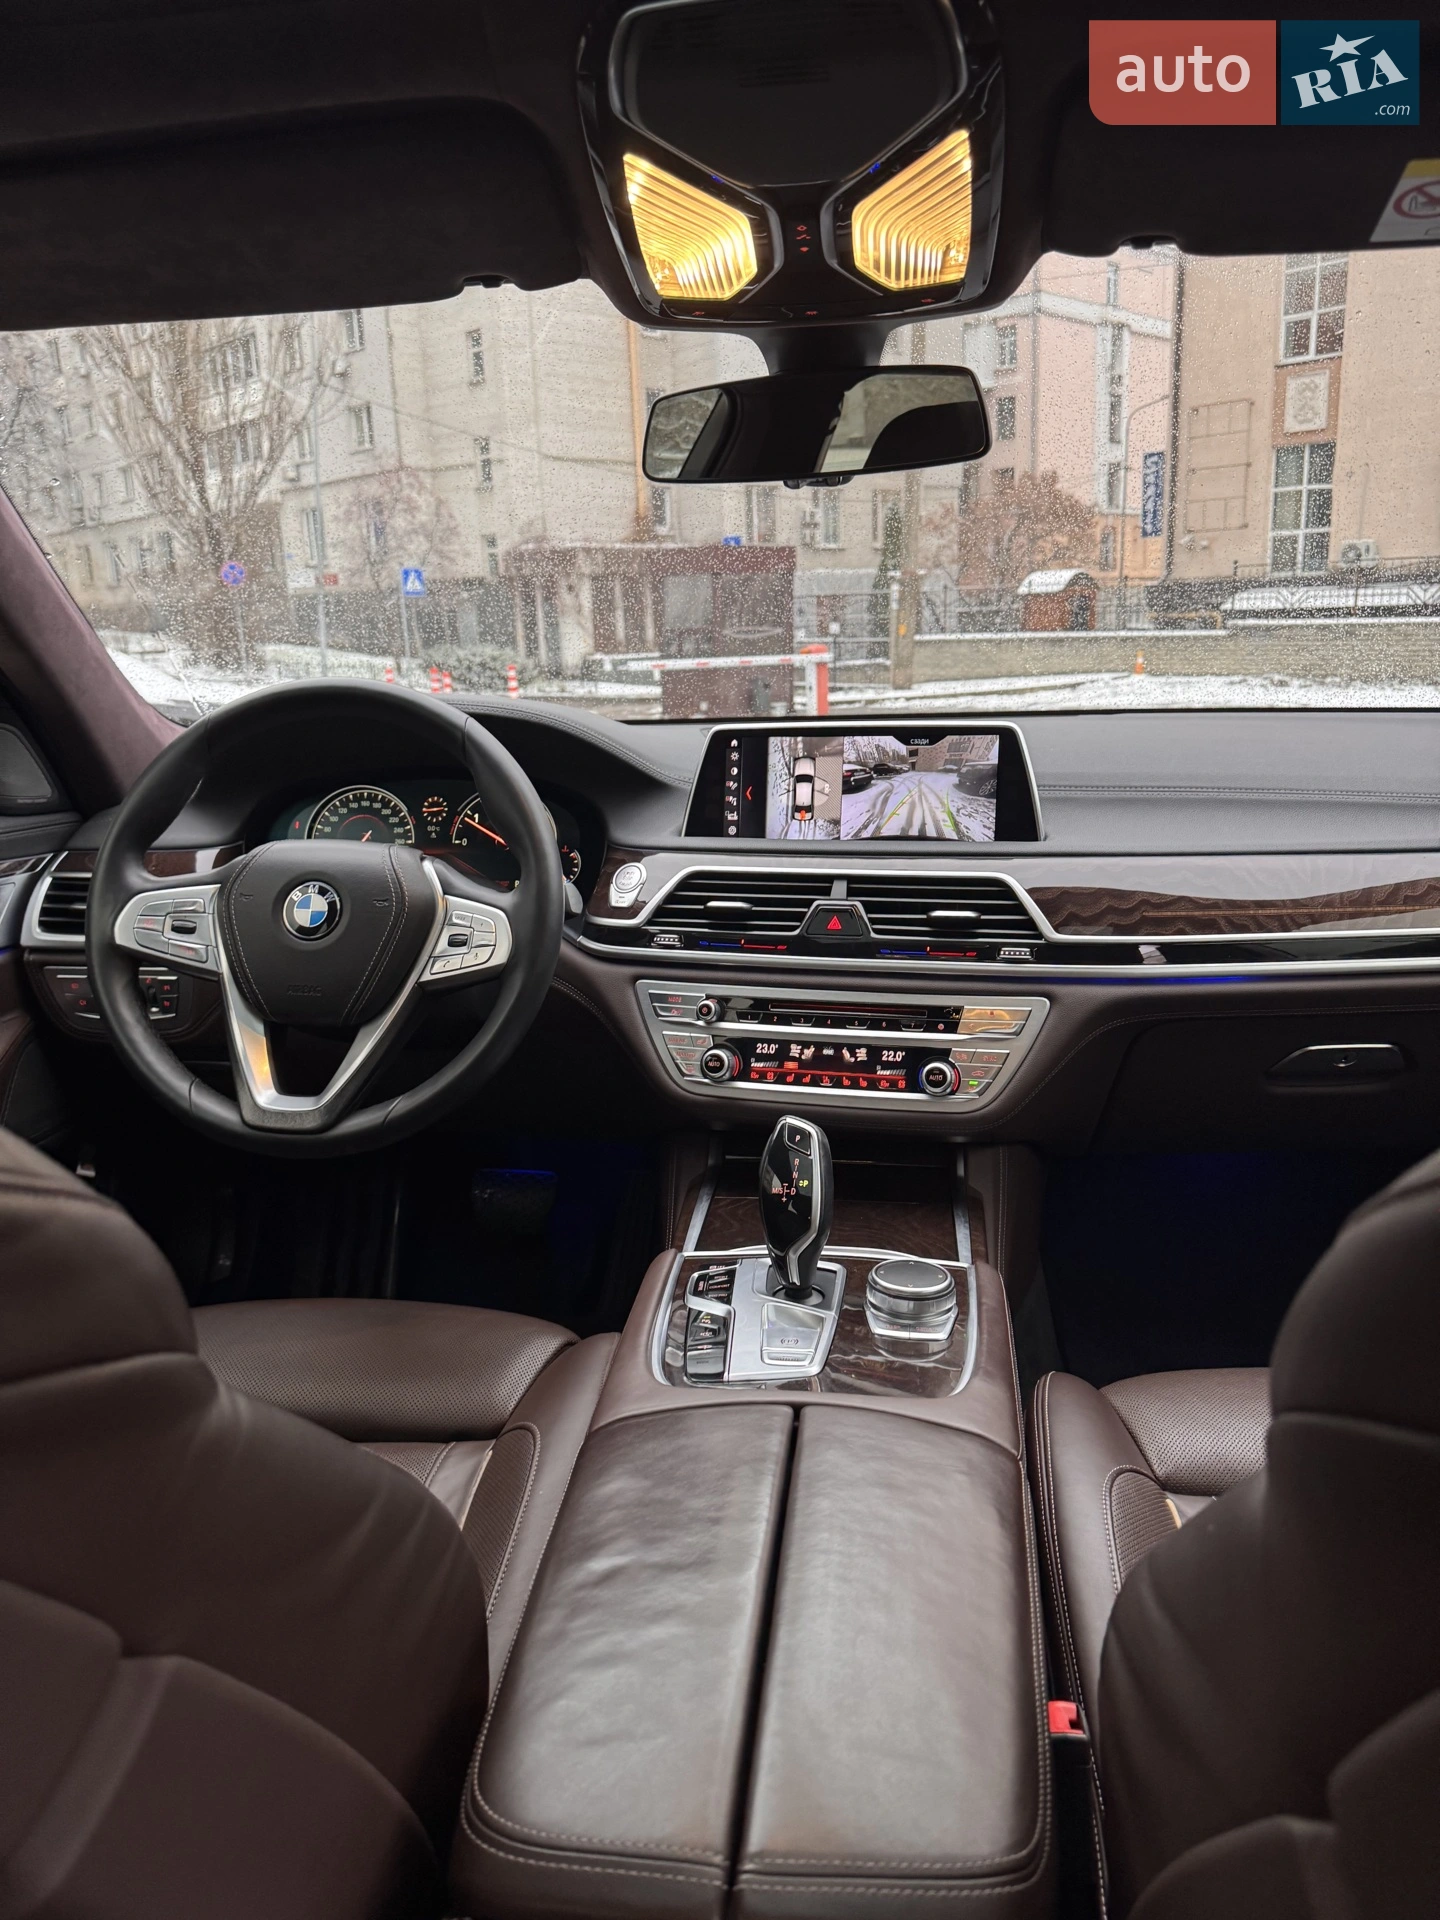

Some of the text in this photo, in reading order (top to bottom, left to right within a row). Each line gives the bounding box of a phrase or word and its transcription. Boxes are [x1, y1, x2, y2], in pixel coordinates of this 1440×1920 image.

[473, 813, 479, 823] 1
[461, 838, 468, 846] 0
[291, 884, 339, 902] BMW
[795, 1134, 801, 1143] P
[794, 1158, 800, 1166] R
[792, 1171, 799, 1179] N
[790, 1187, 797, 1196] D
